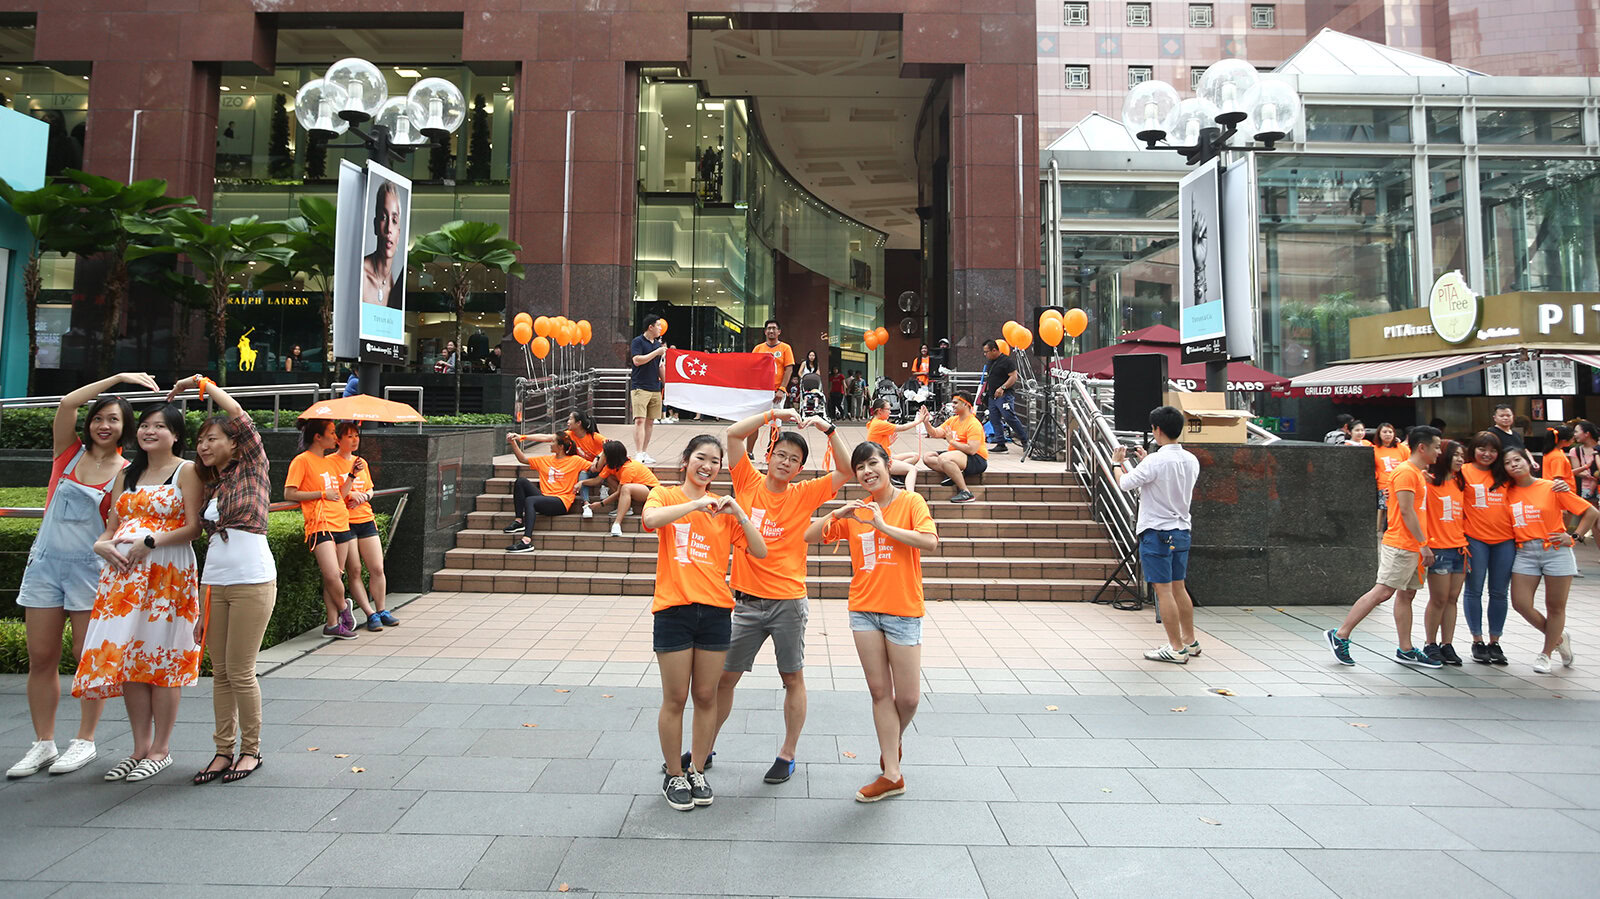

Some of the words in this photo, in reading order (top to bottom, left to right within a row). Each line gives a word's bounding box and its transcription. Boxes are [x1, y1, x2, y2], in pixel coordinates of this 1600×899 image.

[227, 297, 262, 305] RALPH
[267, 297, 309, 305] LAUREN
[1304, 386, 1332, 396] GRILLED
[1334, 384, 1363, 395] KEBABS
[692, 532, 706, 543] Day
[691, 539, 711, 551] Dance
[690, 548, 708, 559] Heart
